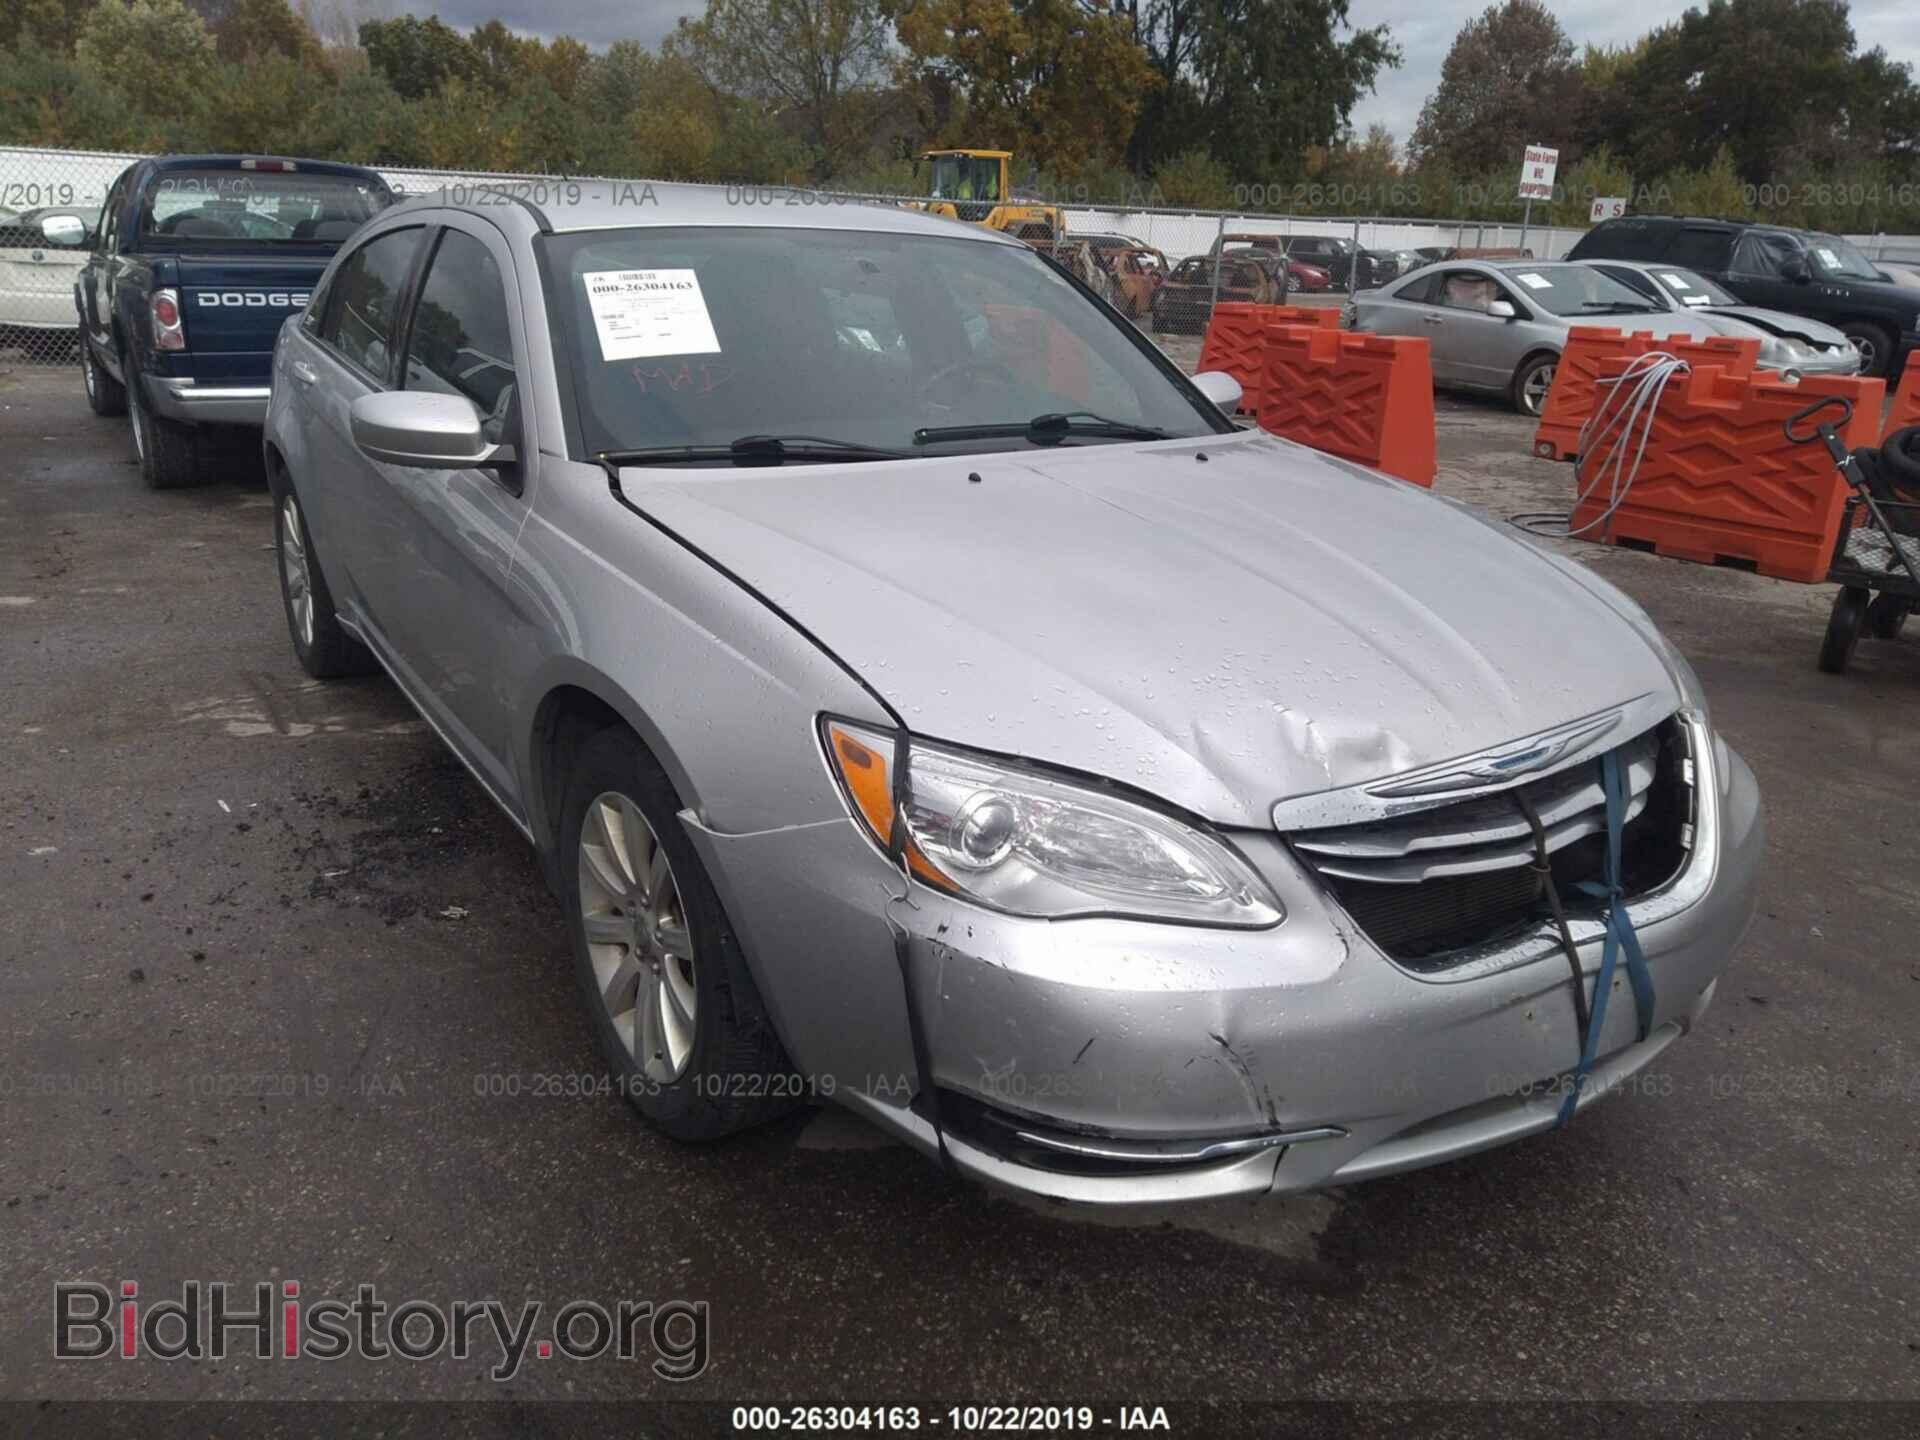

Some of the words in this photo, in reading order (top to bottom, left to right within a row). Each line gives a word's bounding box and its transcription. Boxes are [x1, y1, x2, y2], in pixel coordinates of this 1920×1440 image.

[1593, 203, 1604, 217] R
[1611, 203, 1622, 217] S
[592, 281, 694, 294] 000-26304163
[198, 292, 311, 307] DODGE
